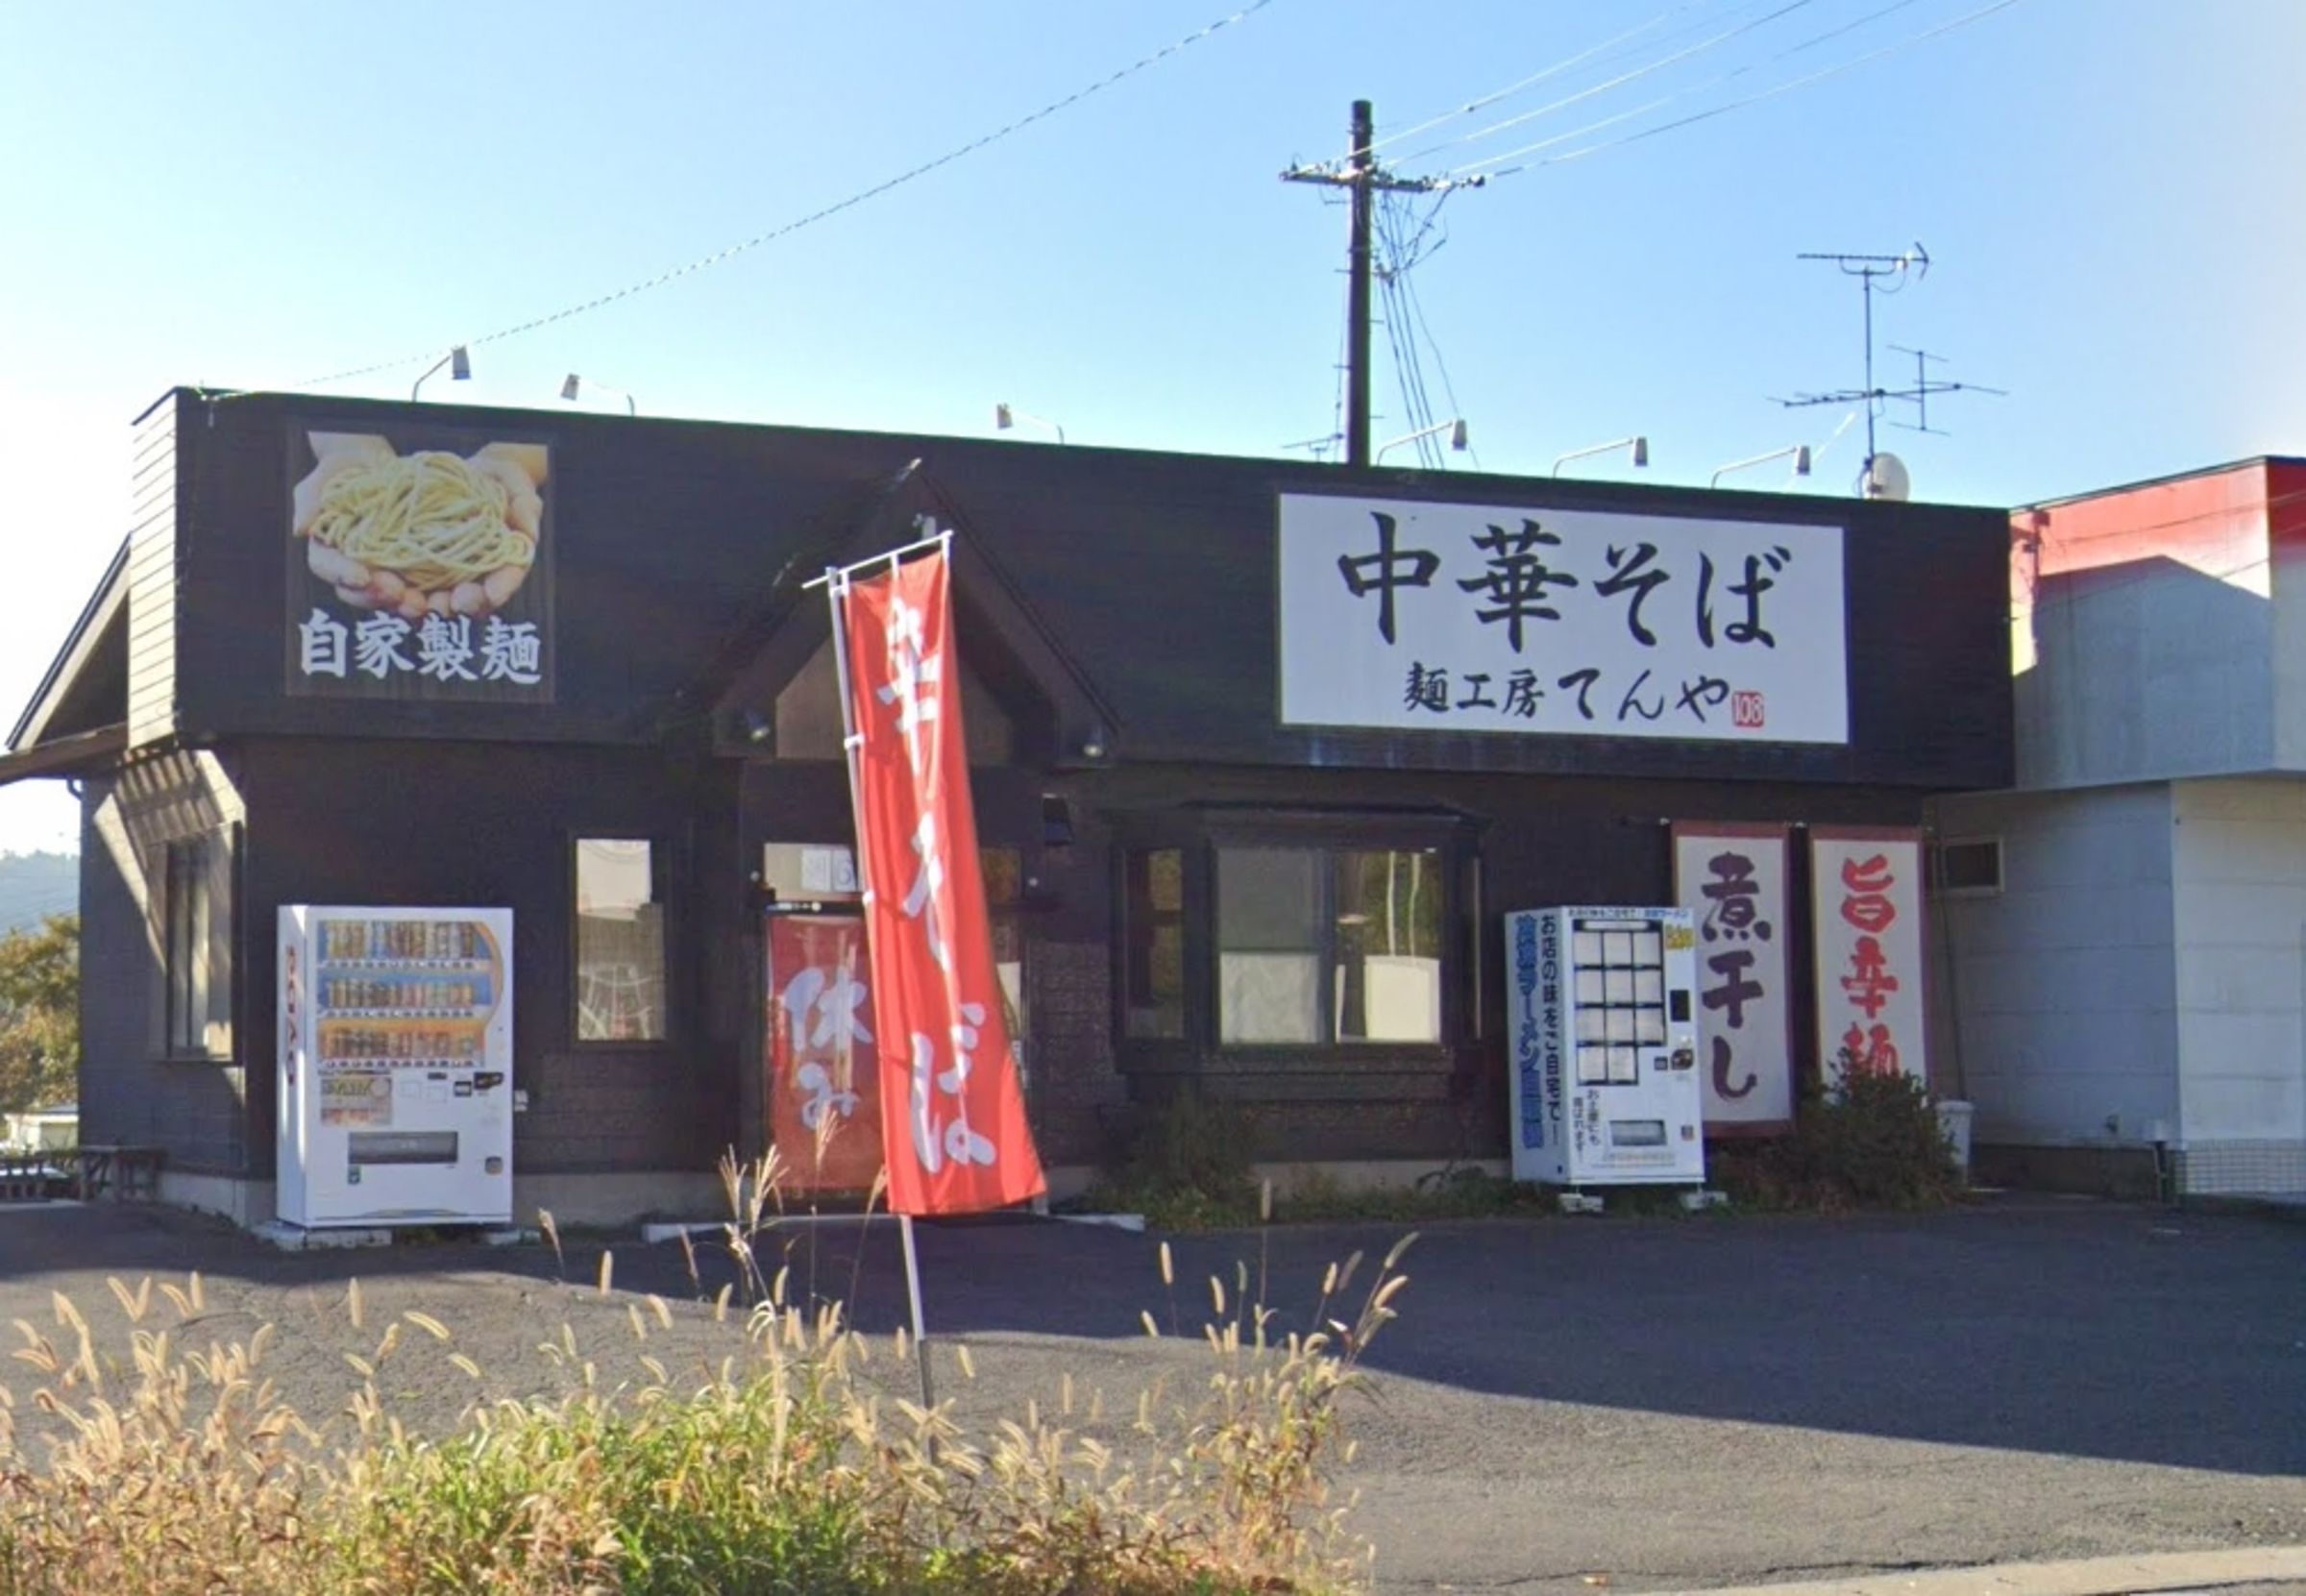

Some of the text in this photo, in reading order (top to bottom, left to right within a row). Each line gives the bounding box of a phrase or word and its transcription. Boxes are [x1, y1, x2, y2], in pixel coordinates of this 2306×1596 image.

[1337, 511, 1793, 653] 中華そば
[298, 607, 541, 684] 自家製麺
[1404, 661, 1730, 723] 麺工房てんや
[1701, 850, 1773, 1100] 煮干し
